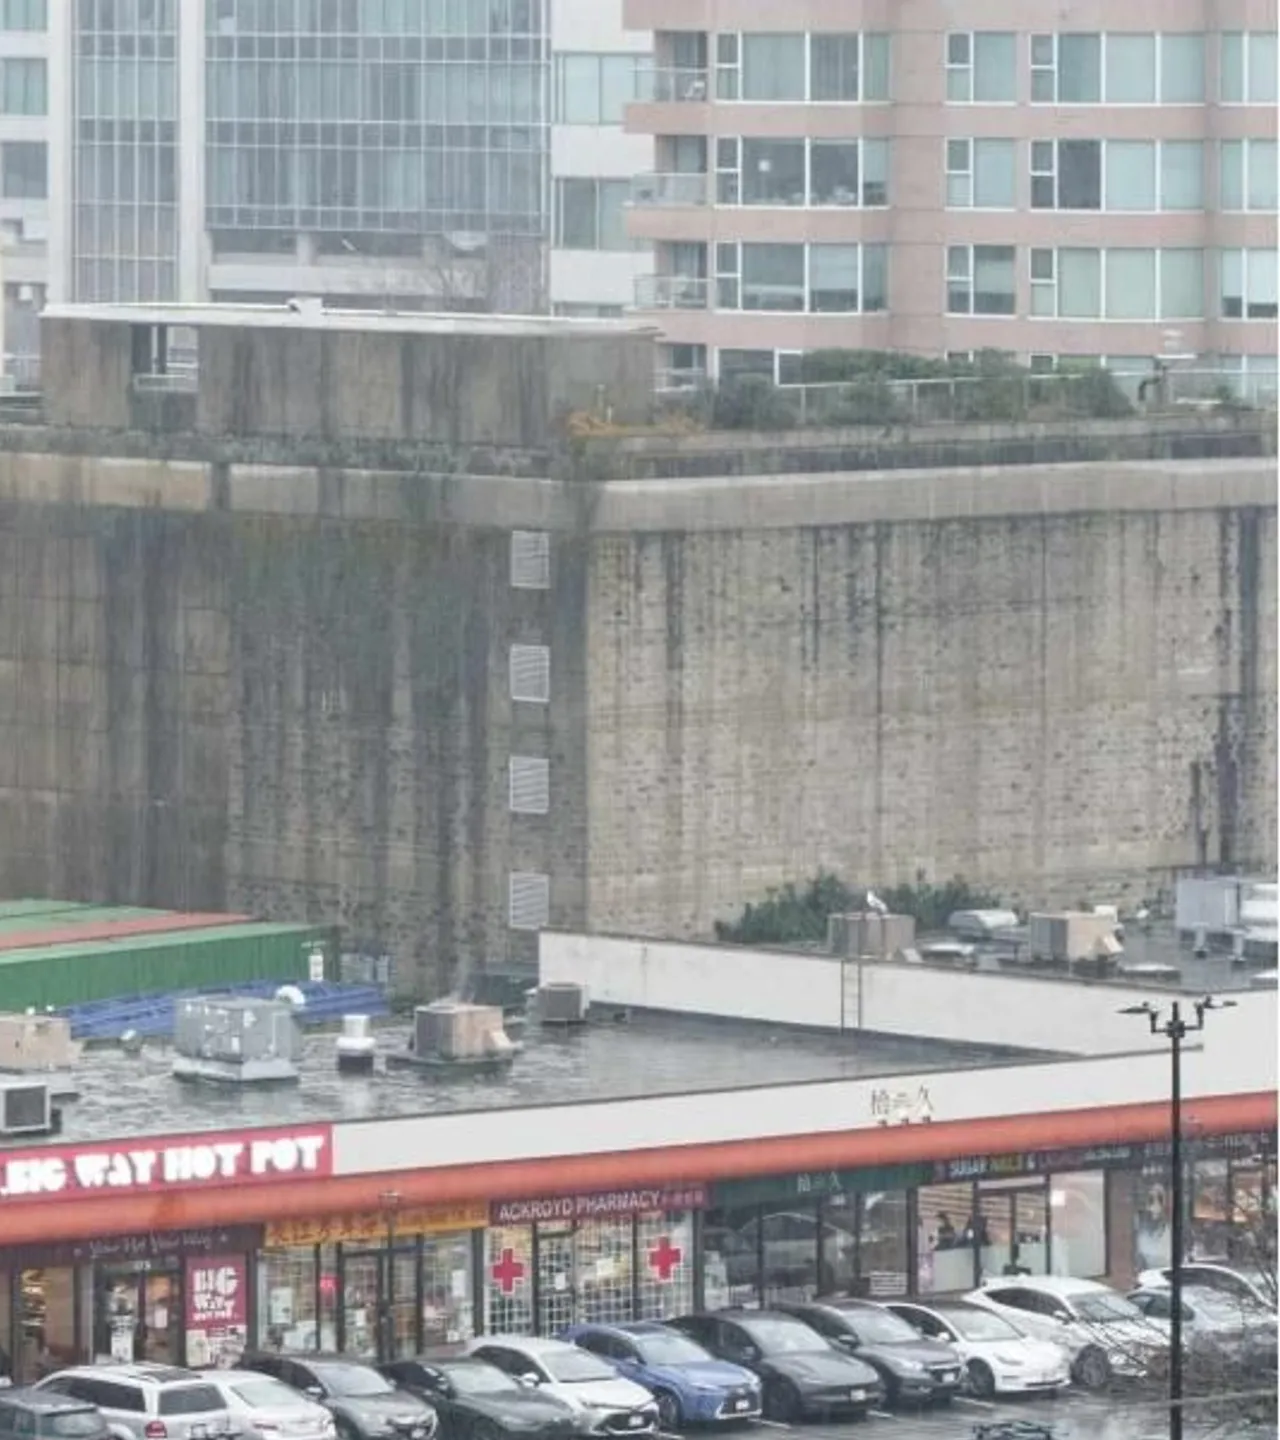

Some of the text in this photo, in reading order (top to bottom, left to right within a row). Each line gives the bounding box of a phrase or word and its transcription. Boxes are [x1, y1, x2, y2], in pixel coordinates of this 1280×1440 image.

[2, 1157, 67, 1195] BIG
[73, 1151, 157, 1189] WAY
[163, 1143, 244, 1183] HOT
[250, 1135, 325, 1175] POT
[498, 1198, 574, 1222] ACKROYD
[575, 1189, 661, 1214] PHARMACY
